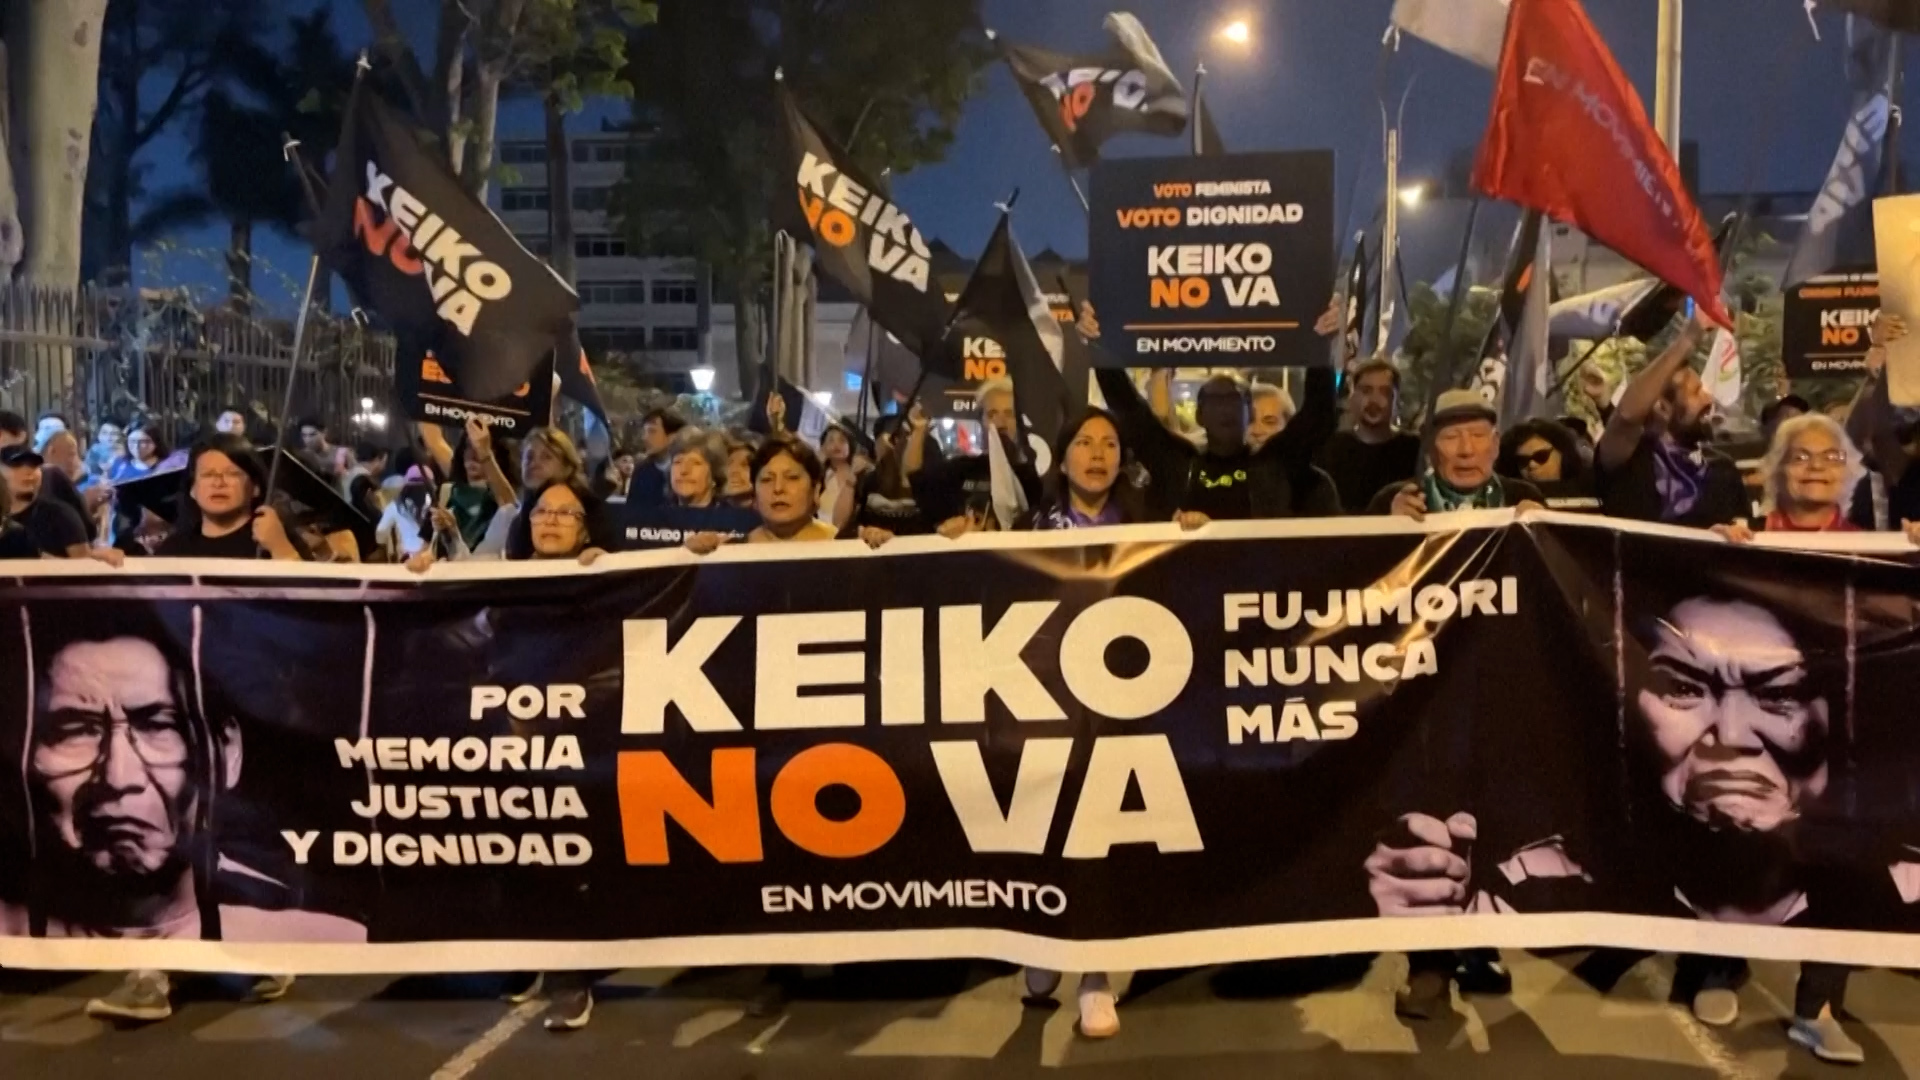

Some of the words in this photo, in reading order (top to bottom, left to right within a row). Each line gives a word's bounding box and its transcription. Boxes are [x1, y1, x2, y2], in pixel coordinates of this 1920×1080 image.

[1153, 182, 1193, 198] VOTO
[1195, 179, 1272, 198] FEMINISTA
[366, 159, 512, 300] KEIKO
[1116, 207, 1182, 228] VOTO
[1186, 203, 1304, 227] DIGNIDAD
[868, 231, 930, 293] VA
[1147, 242, 1273, 276] KEIKO
[1150, 276, 1211, 308] NO
[1221, 275, 1281, 307] VA
[1136, 337, 1161, 352] EN
[1163, 336, 1276, 352] MOVIMIENTO
[1821, 326, 1859, 345] NO
[963, 358, 1007, 381] NO
[952, 399, 970, 412] EN
[1223, 576, 1519, 632] FUJIMORI
[620, 595, 1195, 734] KEIKO
[1224, 638, 1438, 688] NUNCA
[470, 684, 587, 720] POR
[1226, 696, 1360, 745] MÁS
[333, 734, 585, 772] MEMORIA
[350, 782, 589, 819] JUSTICIA
[616, 742, 907, 866] NO
[929, 733, 1205, 859] VA
[280, 830, 321, 864] Y
[333, 831, 594, 866] DIGNIDAD
[761, 885, 812, 913] EN
[822, 879, 1067, 916] MOVIMIENTO
